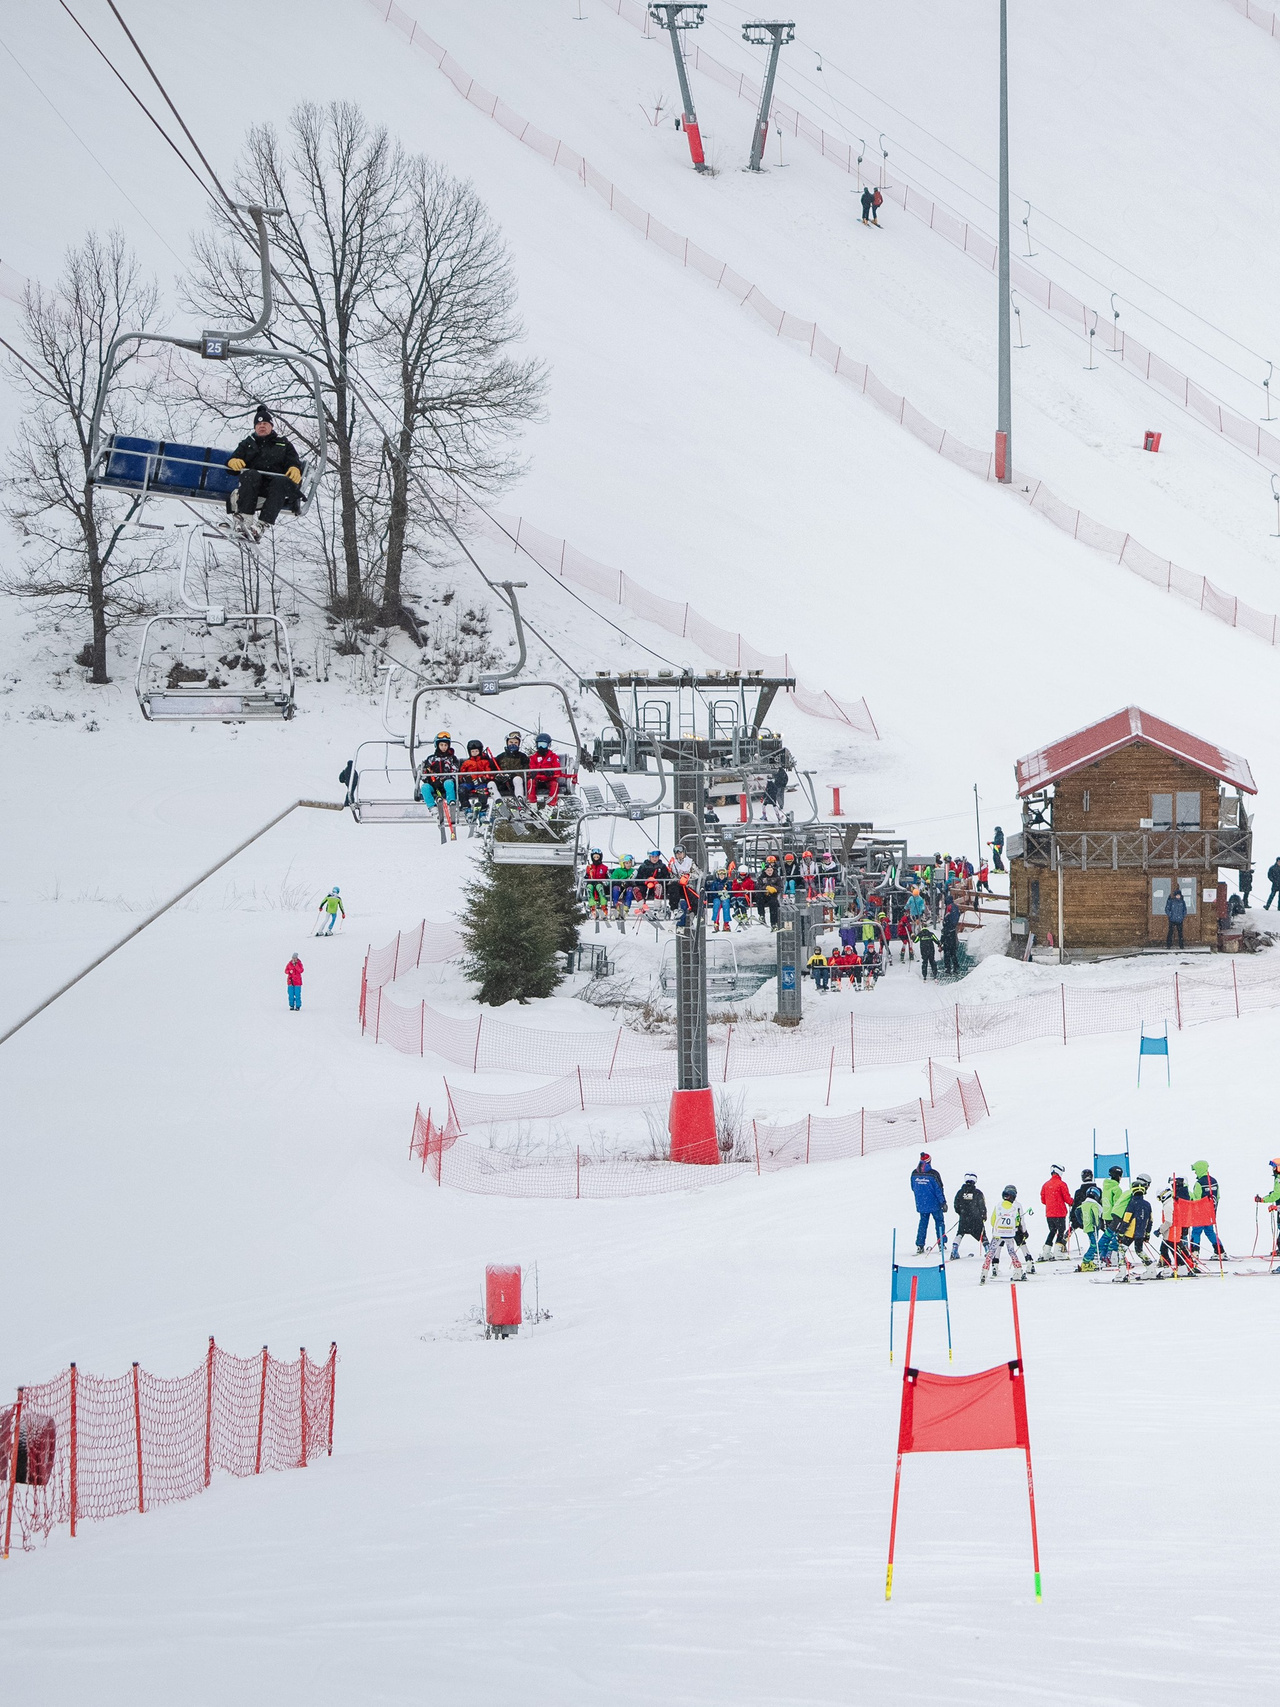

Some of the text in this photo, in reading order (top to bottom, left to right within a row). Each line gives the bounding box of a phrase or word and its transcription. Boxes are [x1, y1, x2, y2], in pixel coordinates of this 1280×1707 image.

[207, 342, 222, 353] 25
[484, 682, 495, 690] 26
[1001, 1217, 1011, 1225] 70
